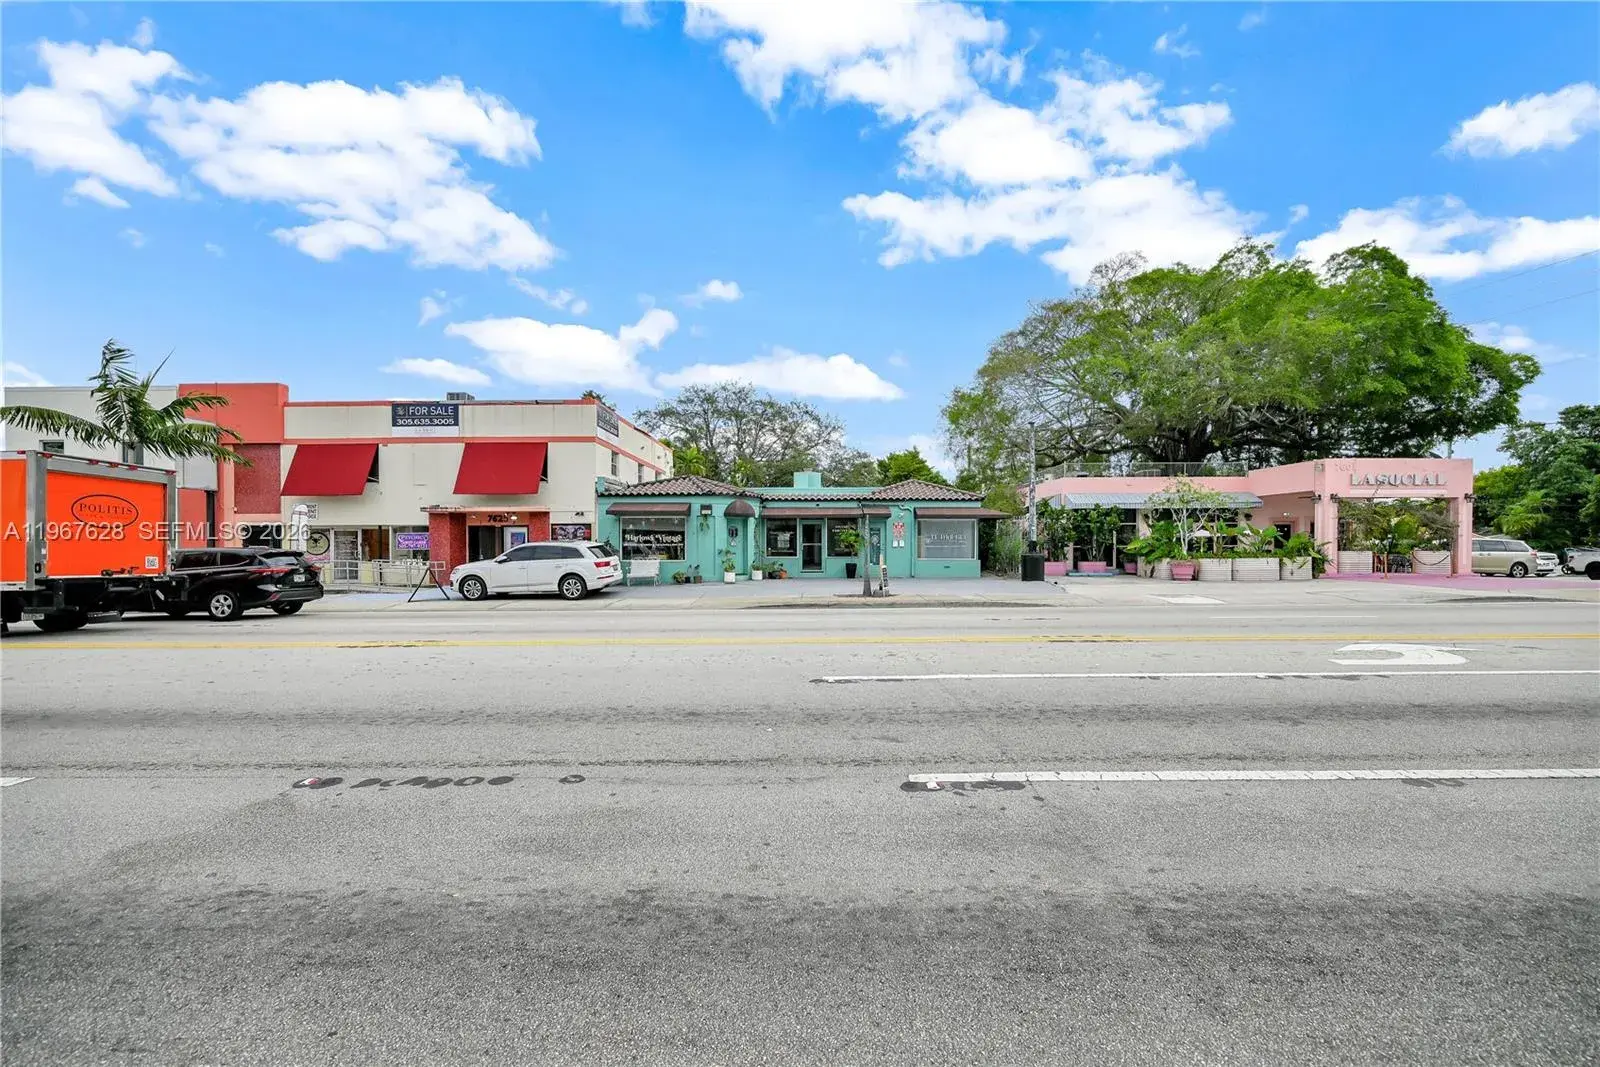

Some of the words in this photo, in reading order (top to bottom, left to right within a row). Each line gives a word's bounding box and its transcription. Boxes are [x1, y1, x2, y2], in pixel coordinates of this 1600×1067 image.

[409, 406, 428, 416] FOR
[430, 406, 455, 416] SALE
[396, 418, 455, 426] 305.635.3005
[80, 503, 133, 515] POLITIS
